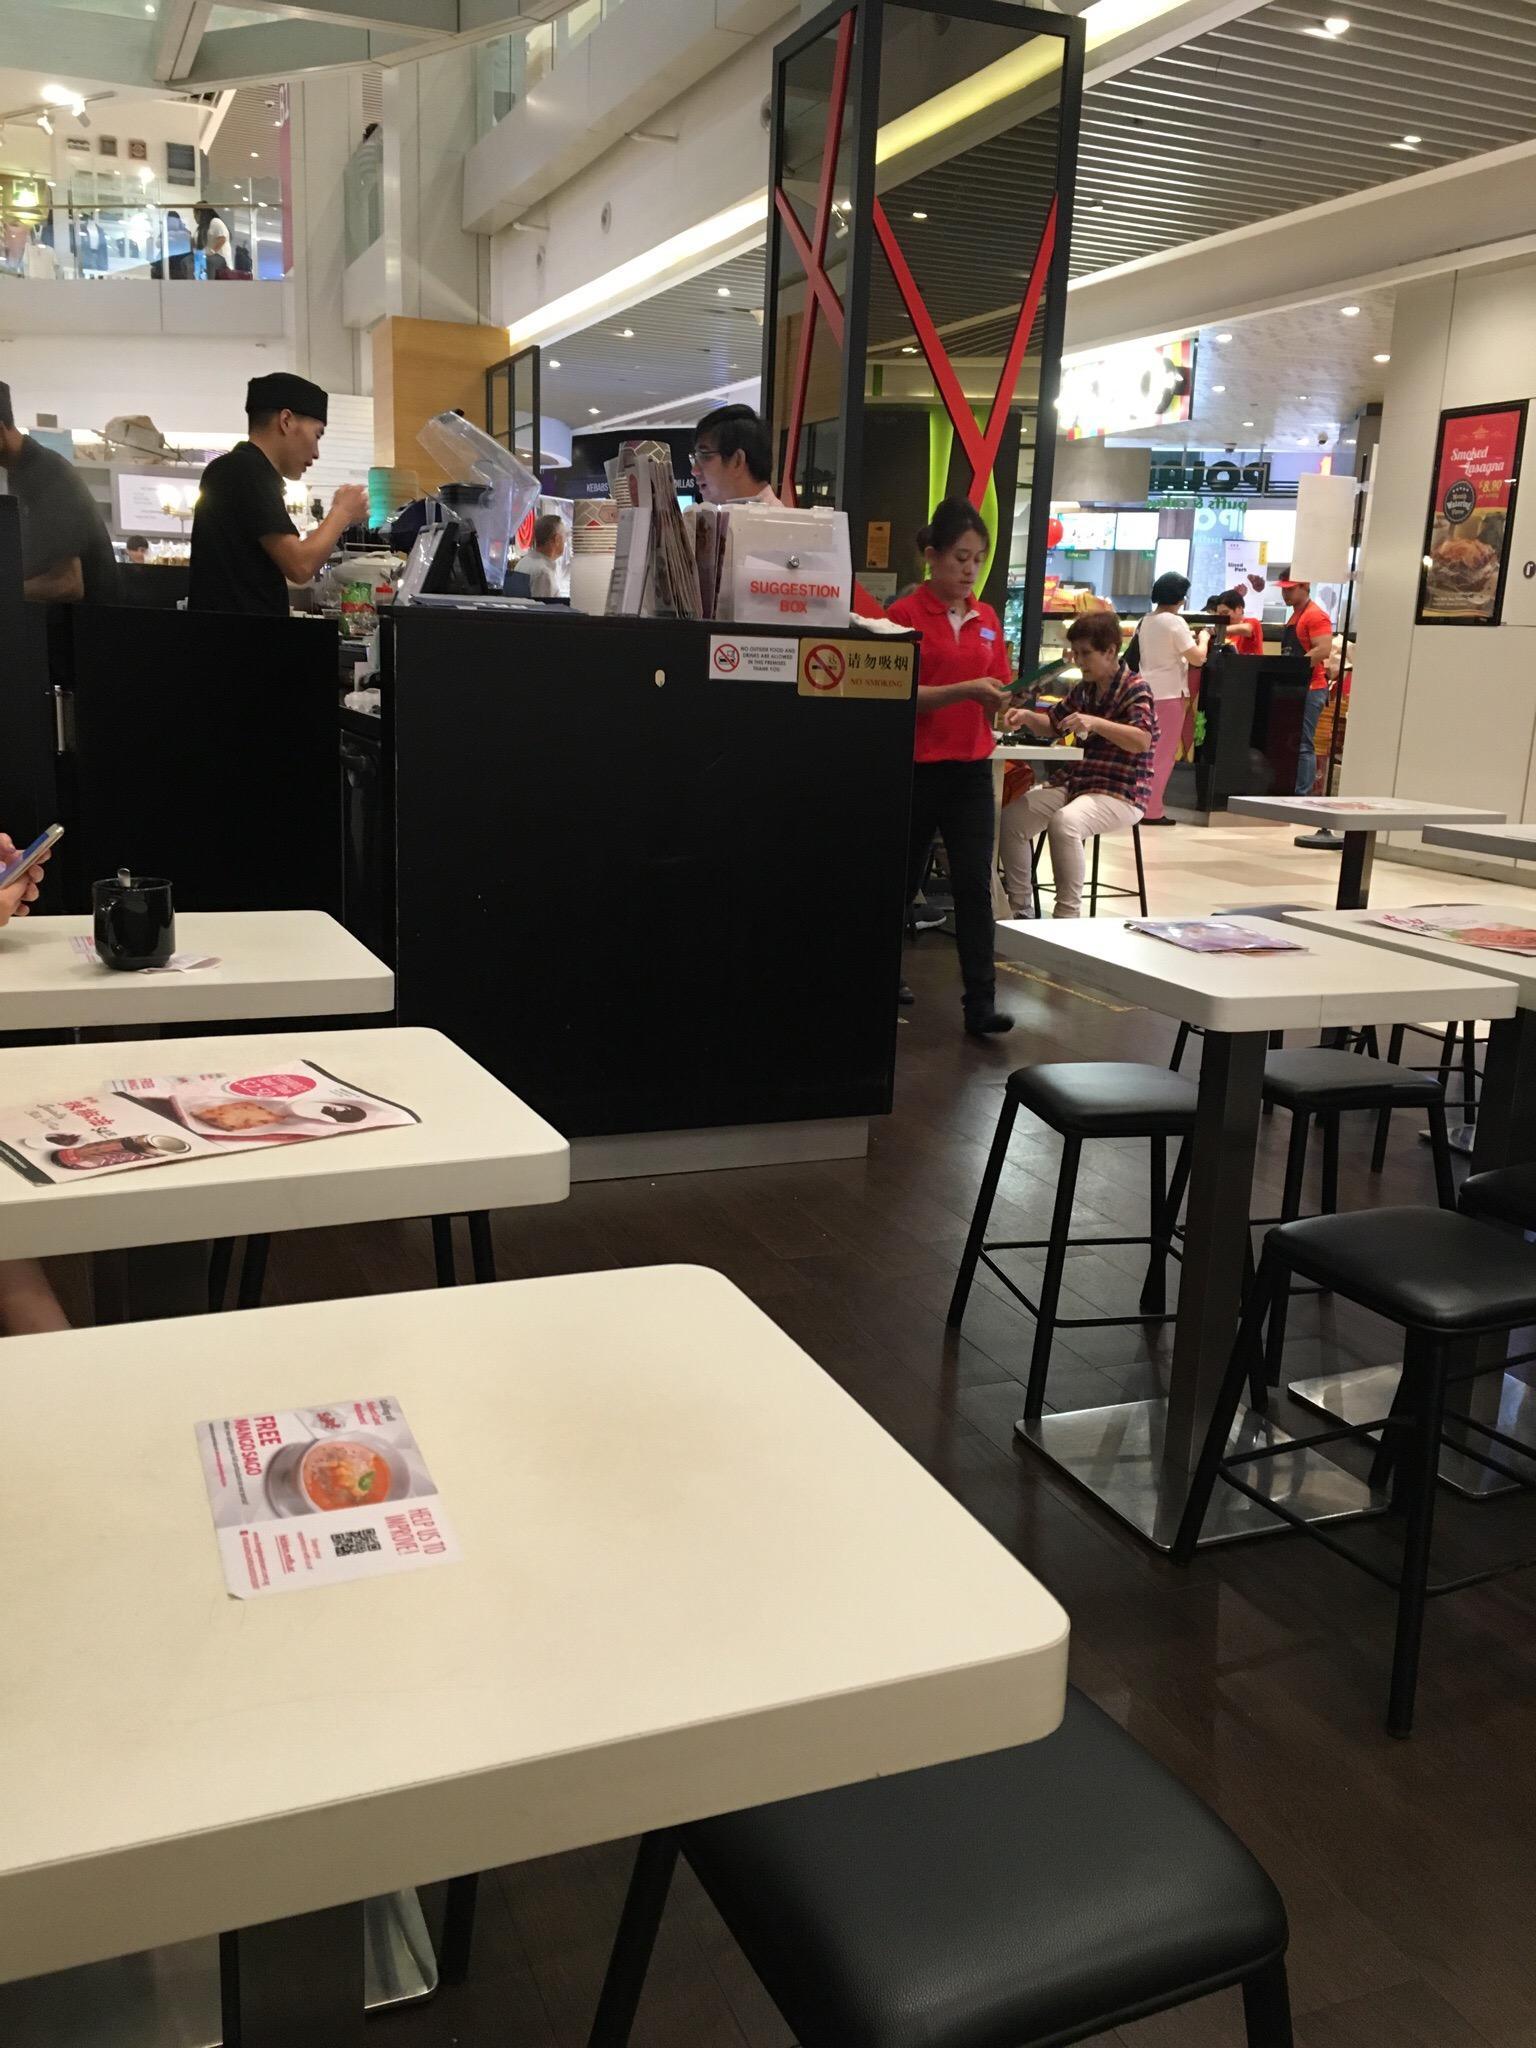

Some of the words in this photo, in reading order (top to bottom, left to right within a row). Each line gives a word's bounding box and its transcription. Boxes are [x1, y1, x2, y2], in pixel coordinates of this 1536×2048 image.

[1458, 461, 1505, 478] Lasagna
[586, 482, 609, 492] KEBABS
[750, 580, 840, 598] SUGGESTION
[779, 600, 807, 614] BOX
[848, 652, 908, 671] 请勿吸烟
[850, 678, 863, 686] NO
[865, 679, 903, 688] SMOKING
[234, 1418, 256, 1452] MANGO
[254, 1415, 282, 1447] FREE
[242, 1451, 262, 1476] SAGO
[408, 1507, 435, 1526] HELP
[384, 1513, 421, 1556] IMPROVE!
[416, 1527, 441, 1541] US
[422, 1541, 447, 1555] TO
